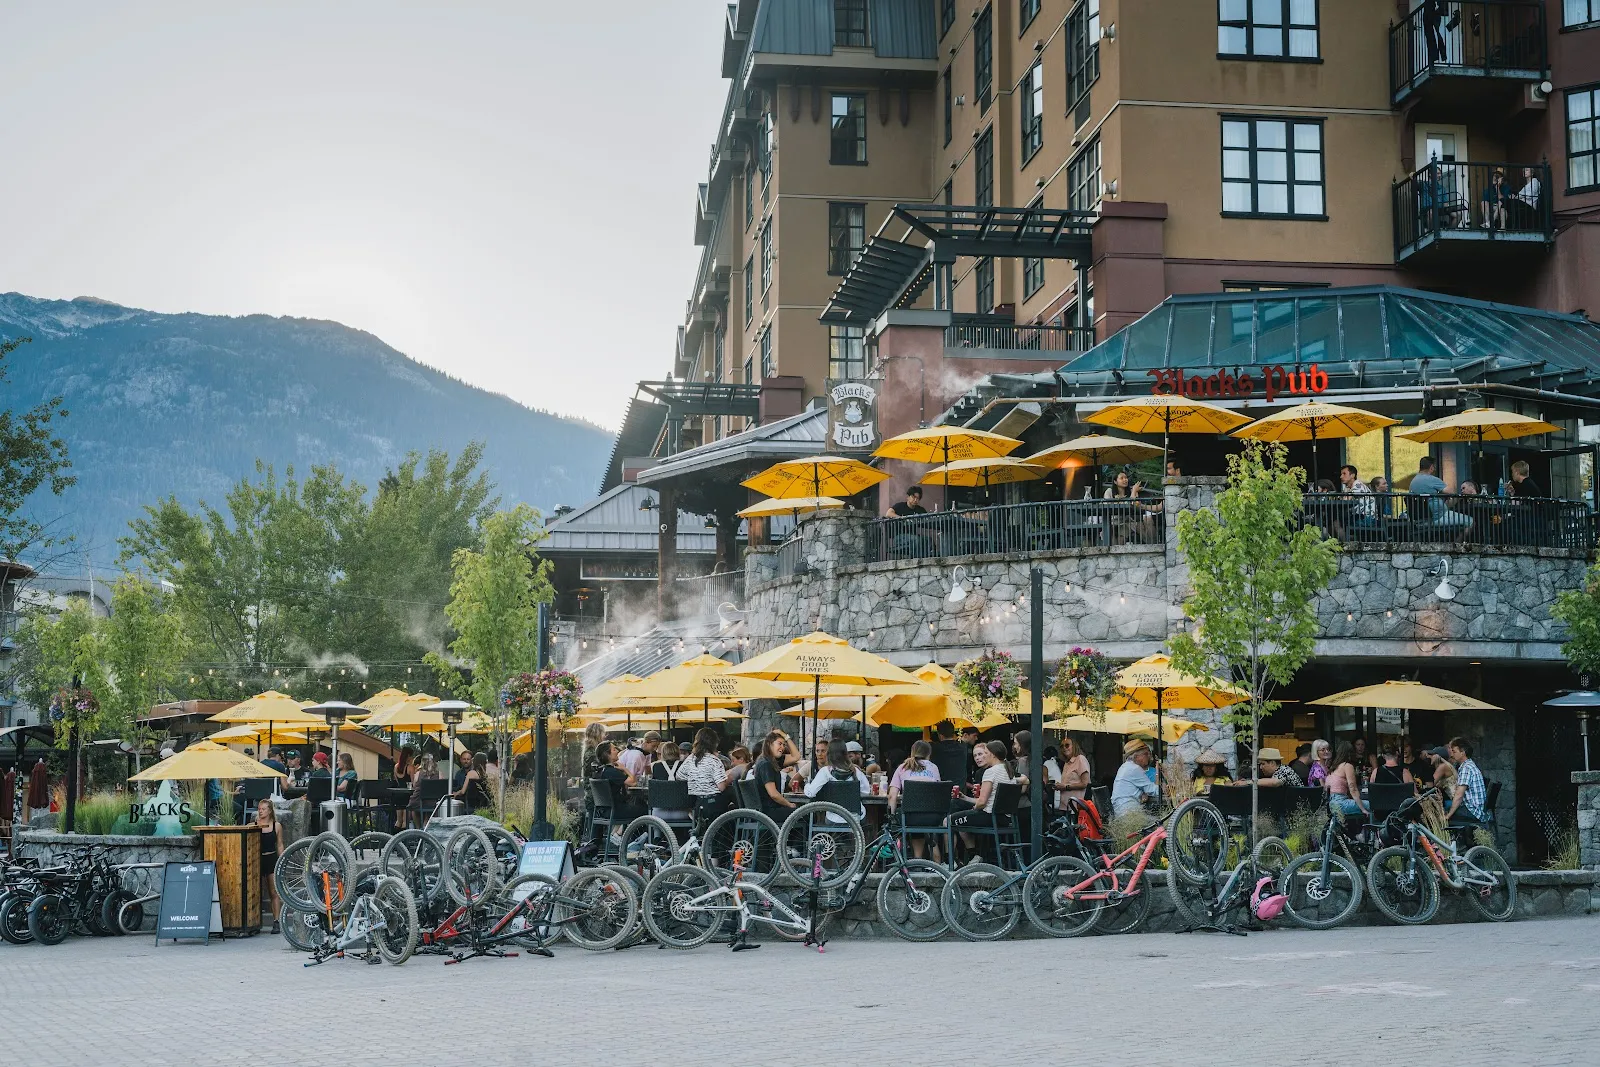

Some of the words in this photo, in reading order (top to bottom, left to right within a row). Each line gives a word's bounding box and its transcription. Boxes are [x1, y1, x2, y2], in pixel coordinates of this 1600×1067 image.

[1262, 363, 1329, 402] Pub
[833, 386, 871, 399] Blacks
[840, 428, 869, 445] Pub
[795, 655, 836, 663] ALWAYS
[128, 802, 191, 824] BLACKS
[954, 816, 968, 826] FOX
[525, 846, 538, 855] JOIN
[537, 846, 546, 855] US
[545, 846, 563, 855] AFTER
